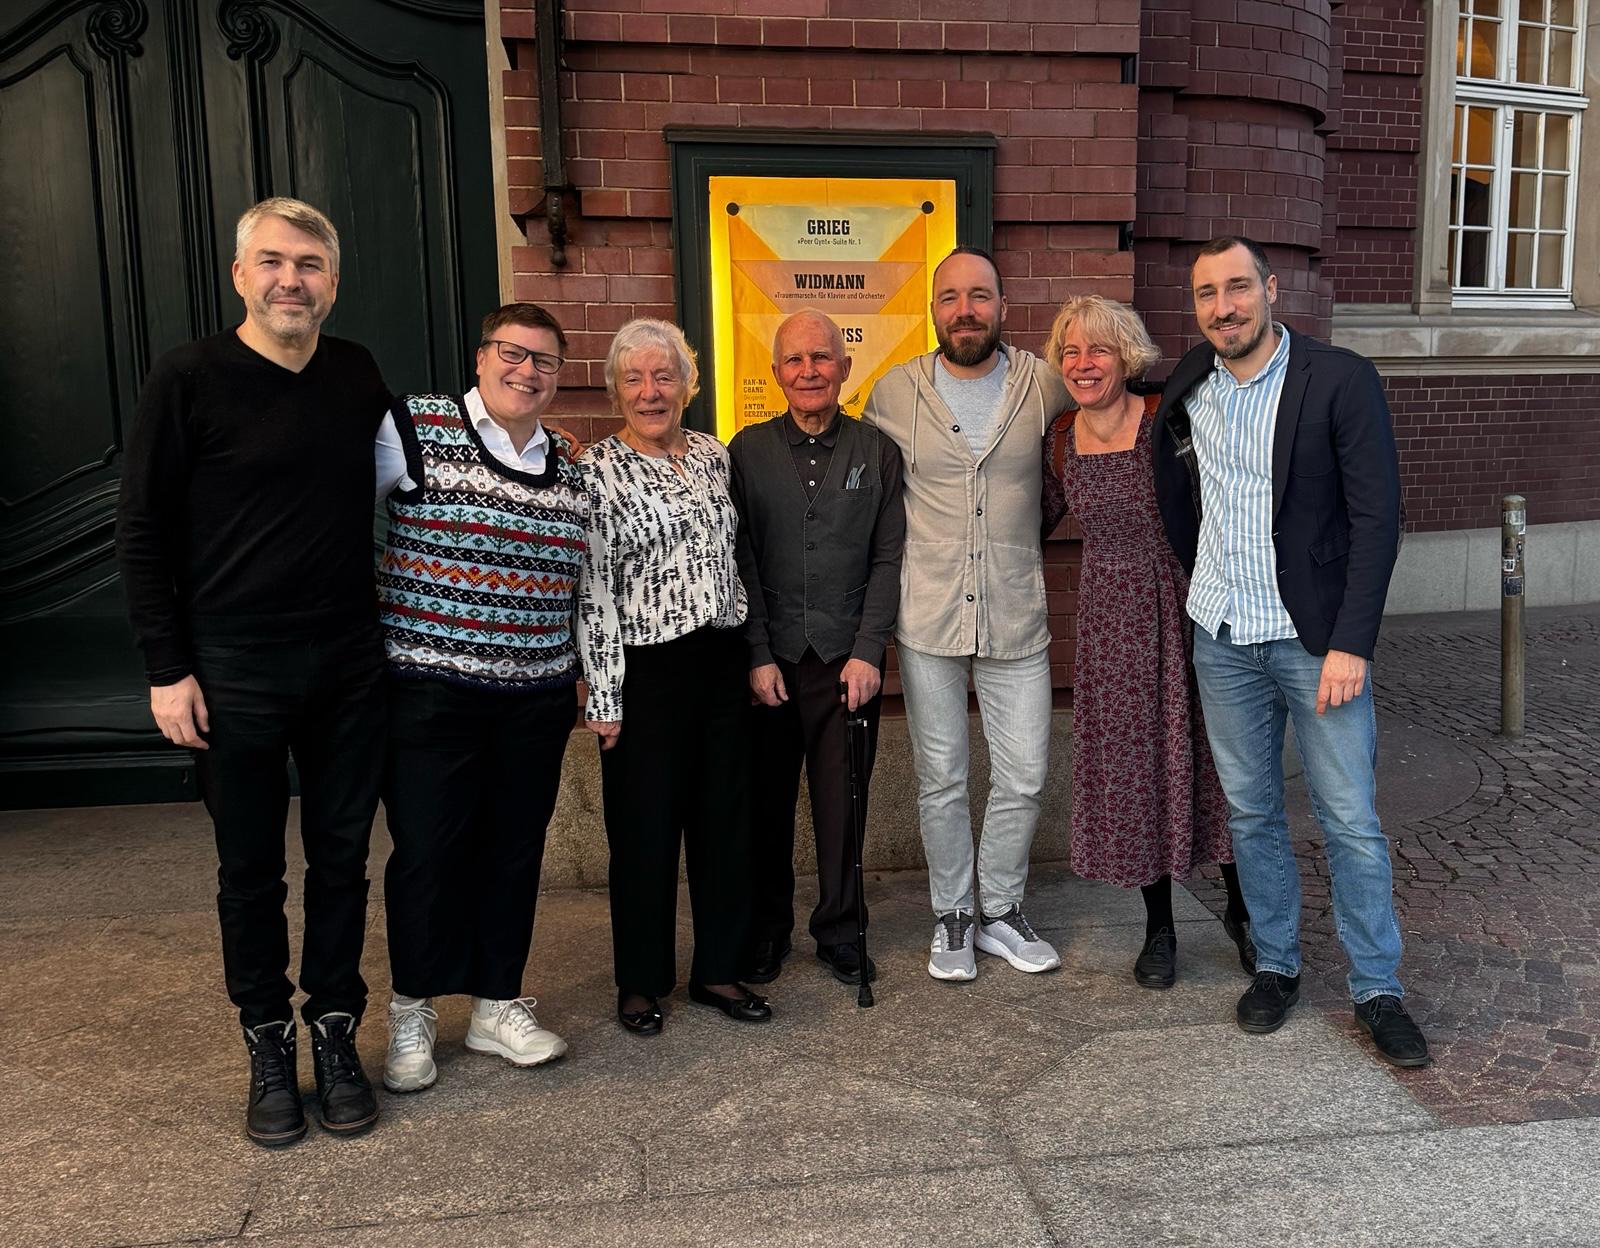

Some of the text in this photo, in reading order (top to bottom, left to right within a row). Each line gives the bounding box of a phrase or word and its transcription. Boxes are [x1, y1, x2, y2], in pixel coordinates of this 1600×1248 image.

[807, 219, 850, 235] GRIEG
[794, 273, 865, 289] WIDMANN
[818, 291, 826, 299] für
